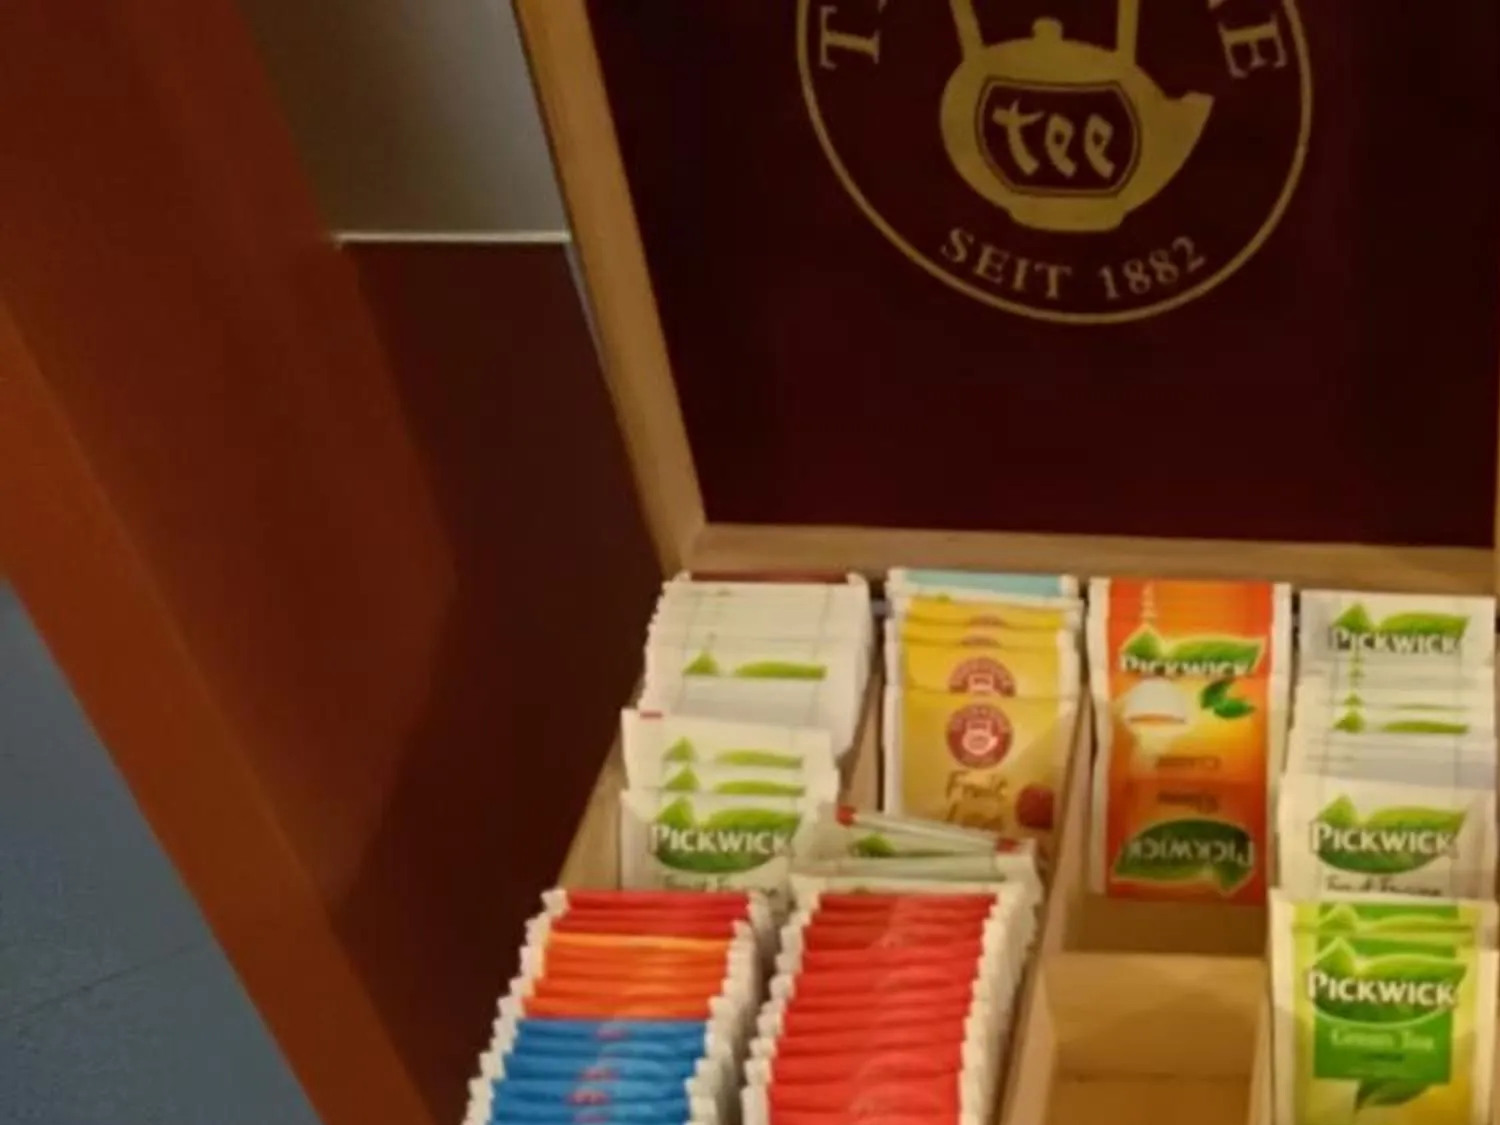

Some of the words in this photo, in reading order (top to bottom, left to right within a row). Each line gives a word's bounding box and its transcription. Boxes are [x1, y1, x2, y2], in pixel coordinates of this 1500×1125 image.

[993, 99, 1114, 178] tee
[941, 227, 1072, 300] SEIT
[1101, 236, 1206, 299] 1882
[651, 824, 790, 855] PICKWICK
[1130, 837, 1255, 868] PICKWICK
[1311, 822, 1456, 857] PICKWICK
[1308, 970, 1457, 1009] PICKWICK
